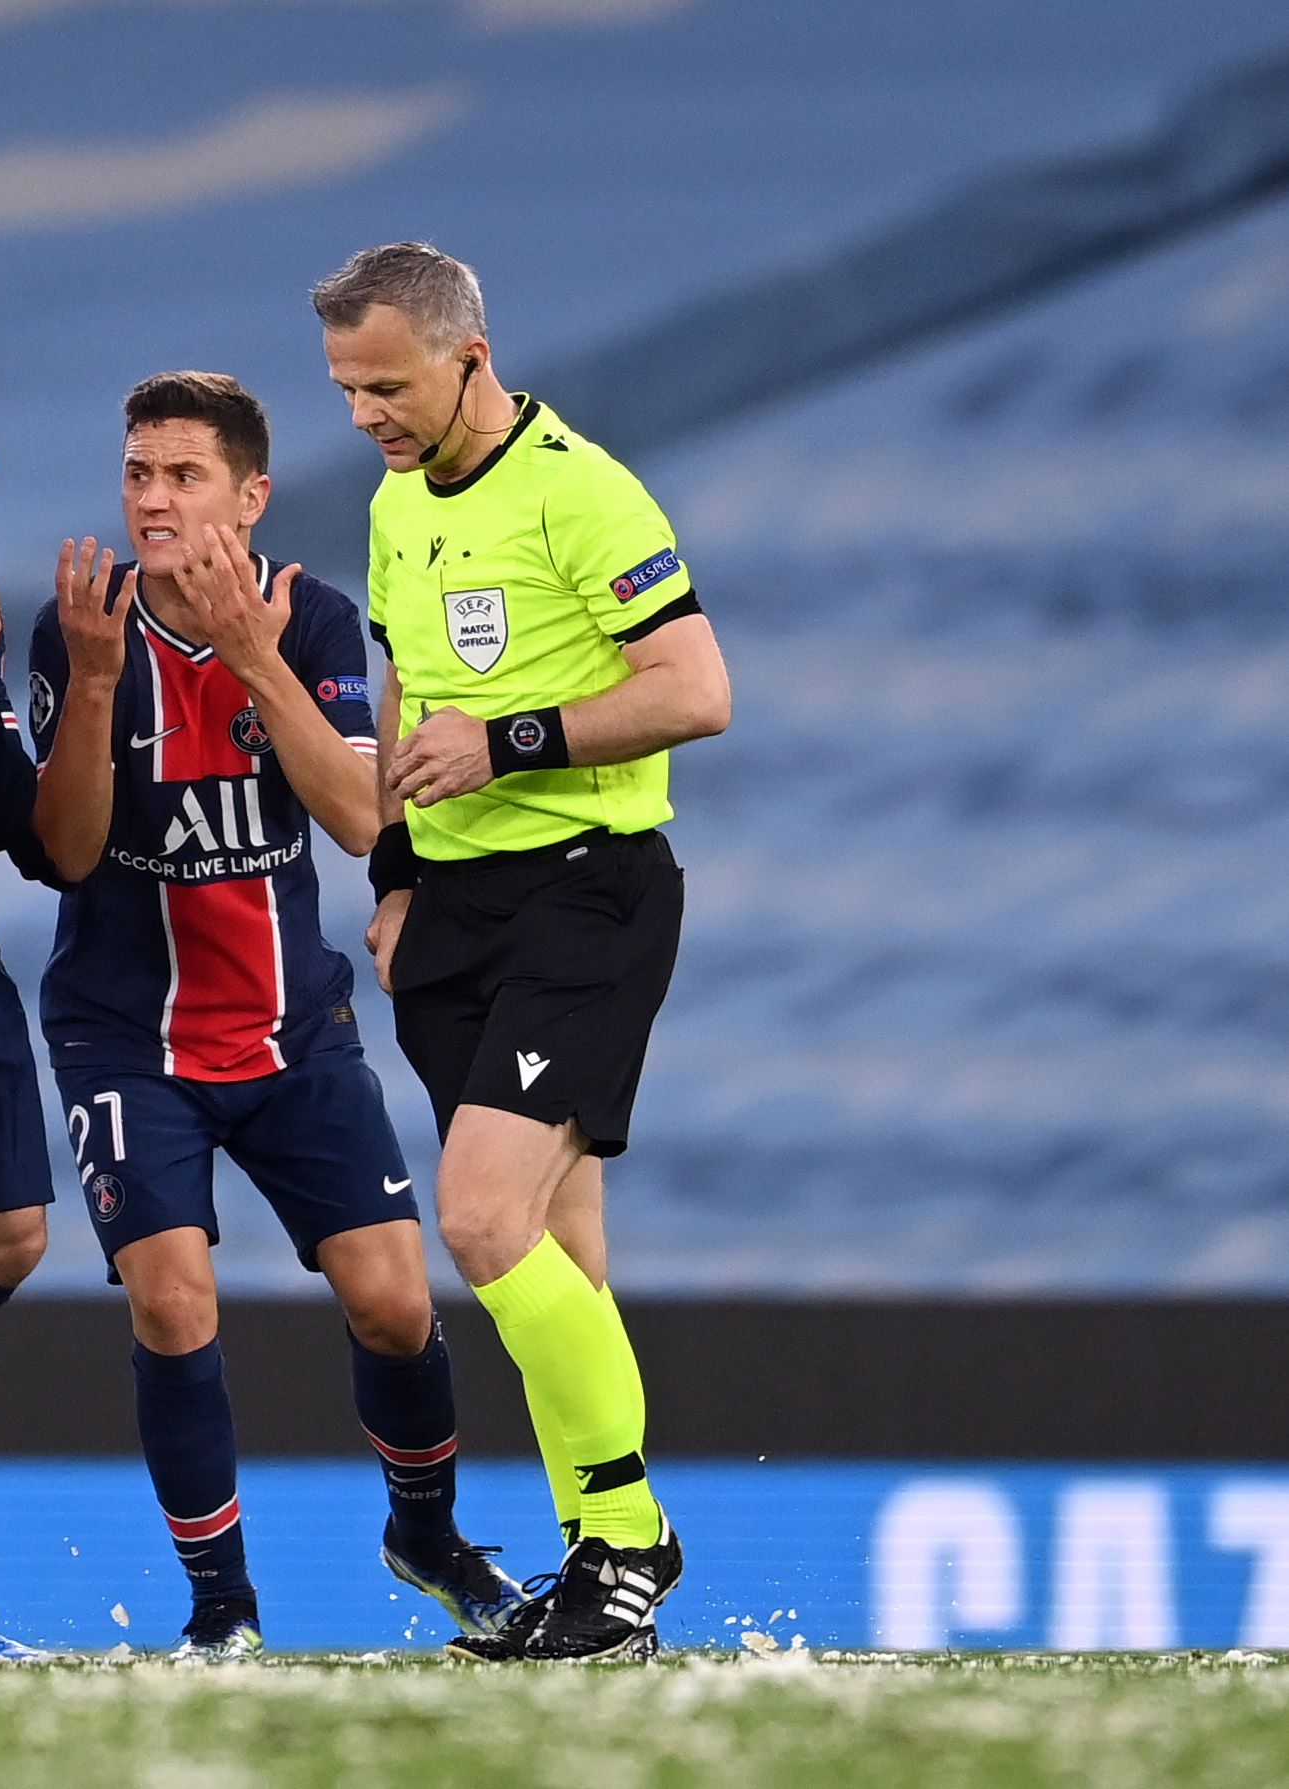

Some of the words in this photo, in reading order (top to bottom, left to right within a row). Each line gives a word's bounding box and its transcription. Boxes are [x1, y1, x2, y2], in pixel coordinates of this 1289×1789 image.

[631, 554, 677, 587] RESPECT
[456, 599, 492, 615] UEFA
[461, 624, 494, 635] MATCH
[457, 636, 501, 647] OFFICIAL
[182, 857, 225, 879] LIVE
[69, 1091, 126, 1185] 21
[389, 1483, 442, 1499] PARIS
